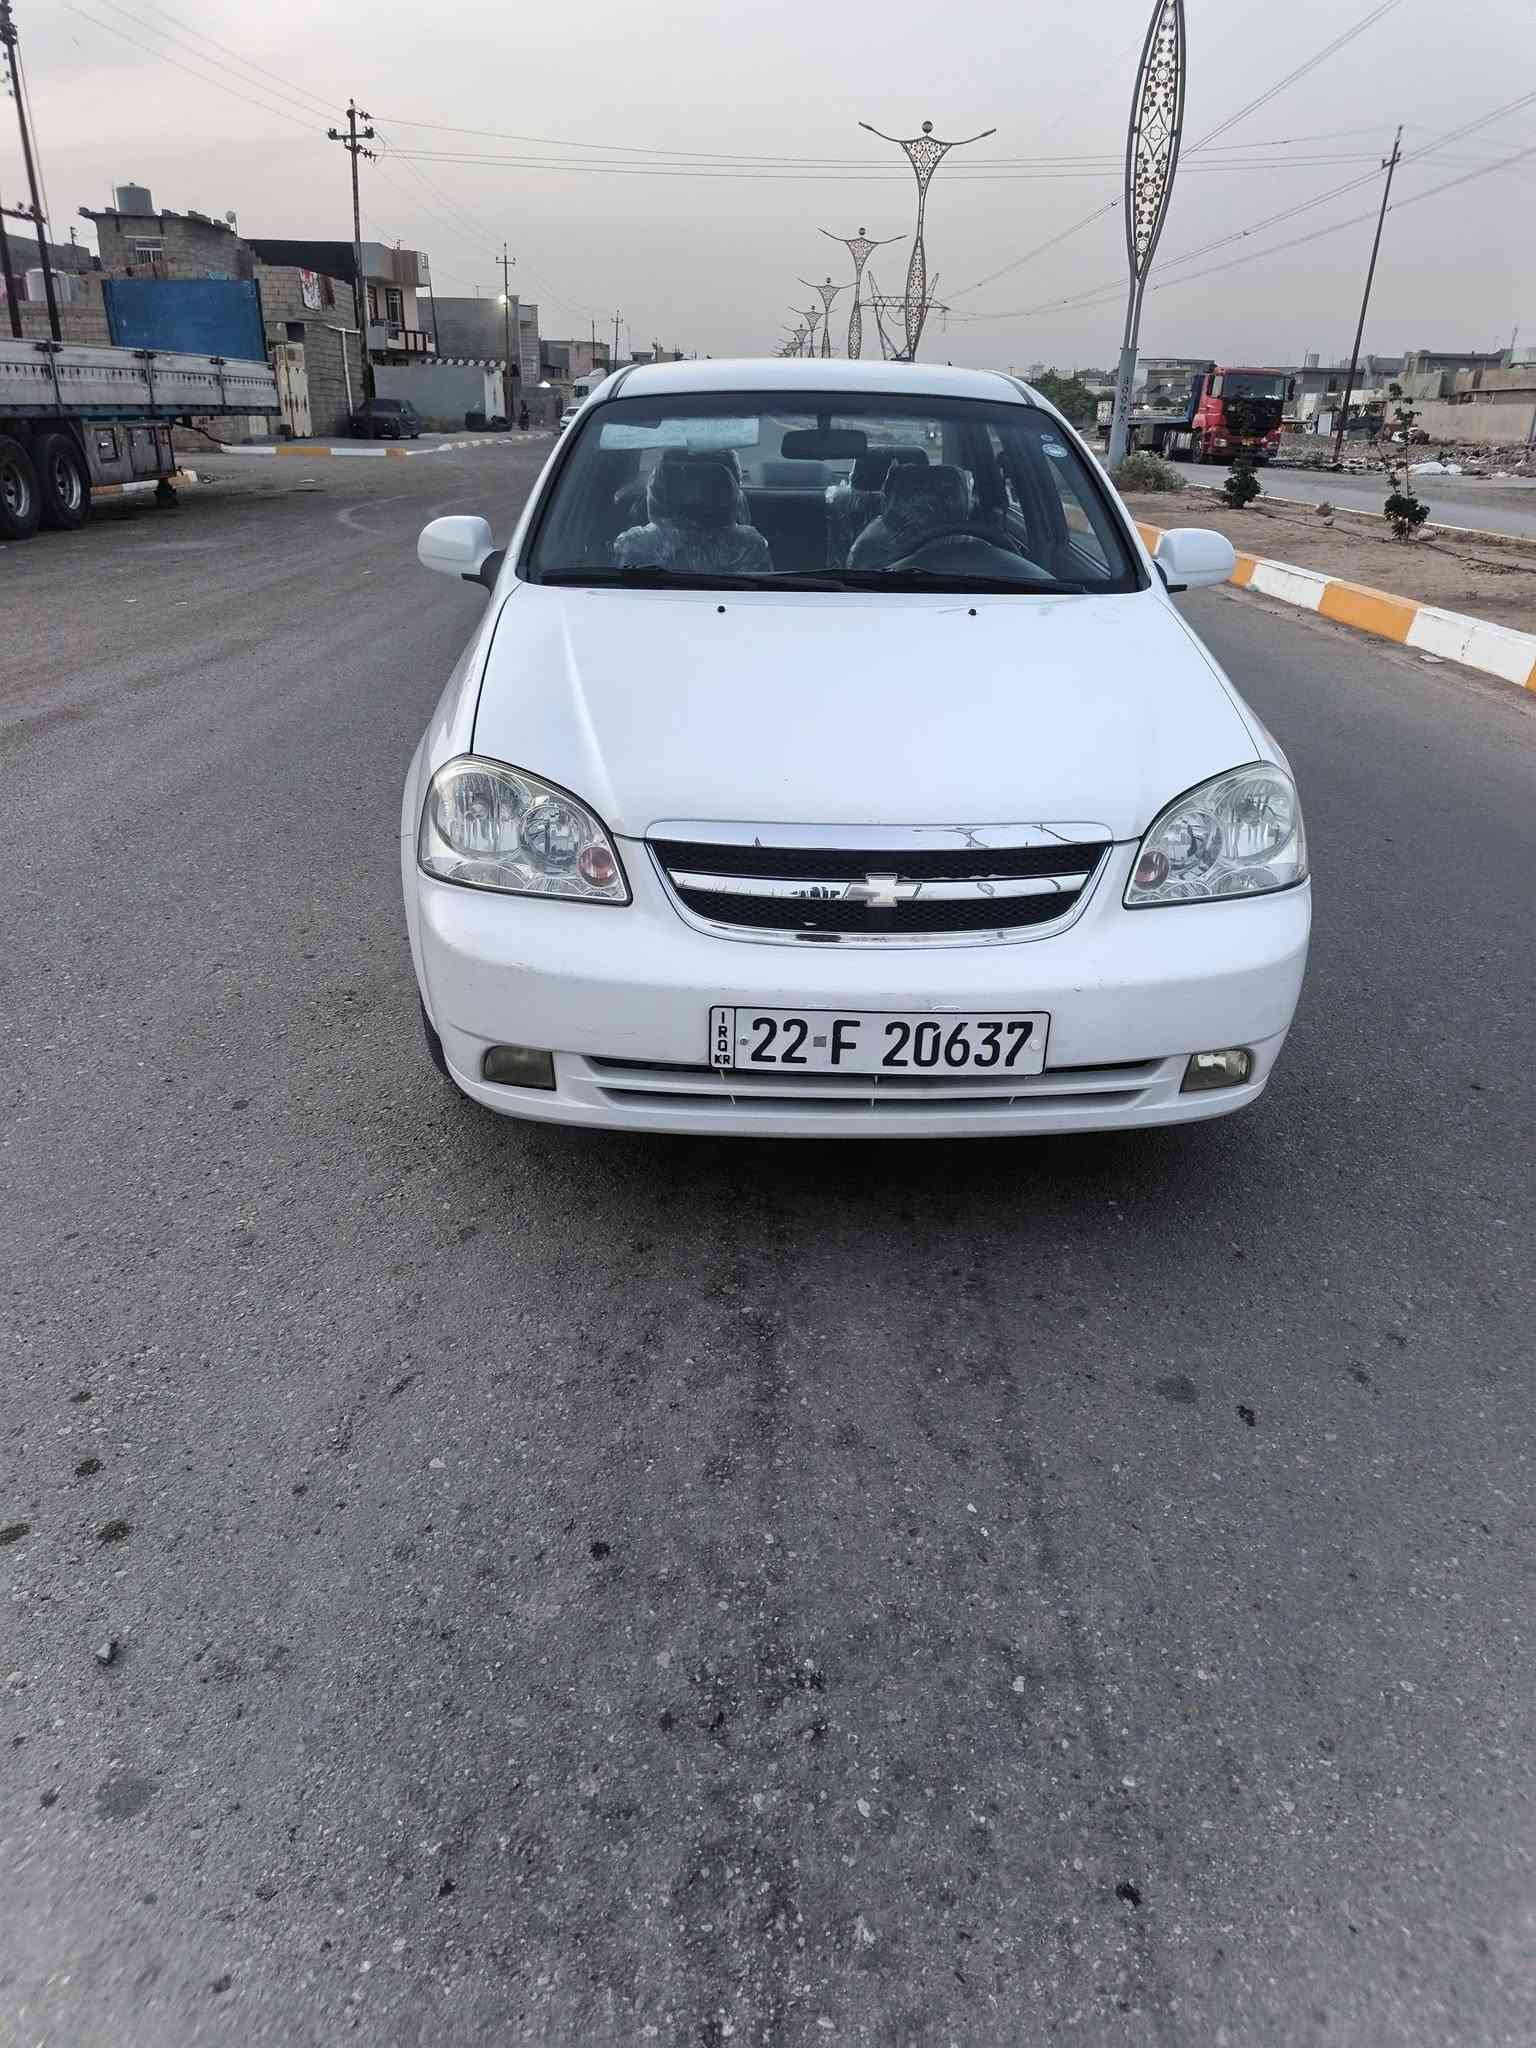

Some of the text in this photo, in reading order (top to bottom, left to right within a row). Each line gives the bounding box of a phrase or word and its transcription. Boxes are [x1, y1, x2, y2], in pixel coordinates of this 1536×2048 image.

[717, 1011, 728, 1052] IRQ
[750, 1017, 1034, 1067] 22 F 20637
[714, 1054, 730, 1065] KR
